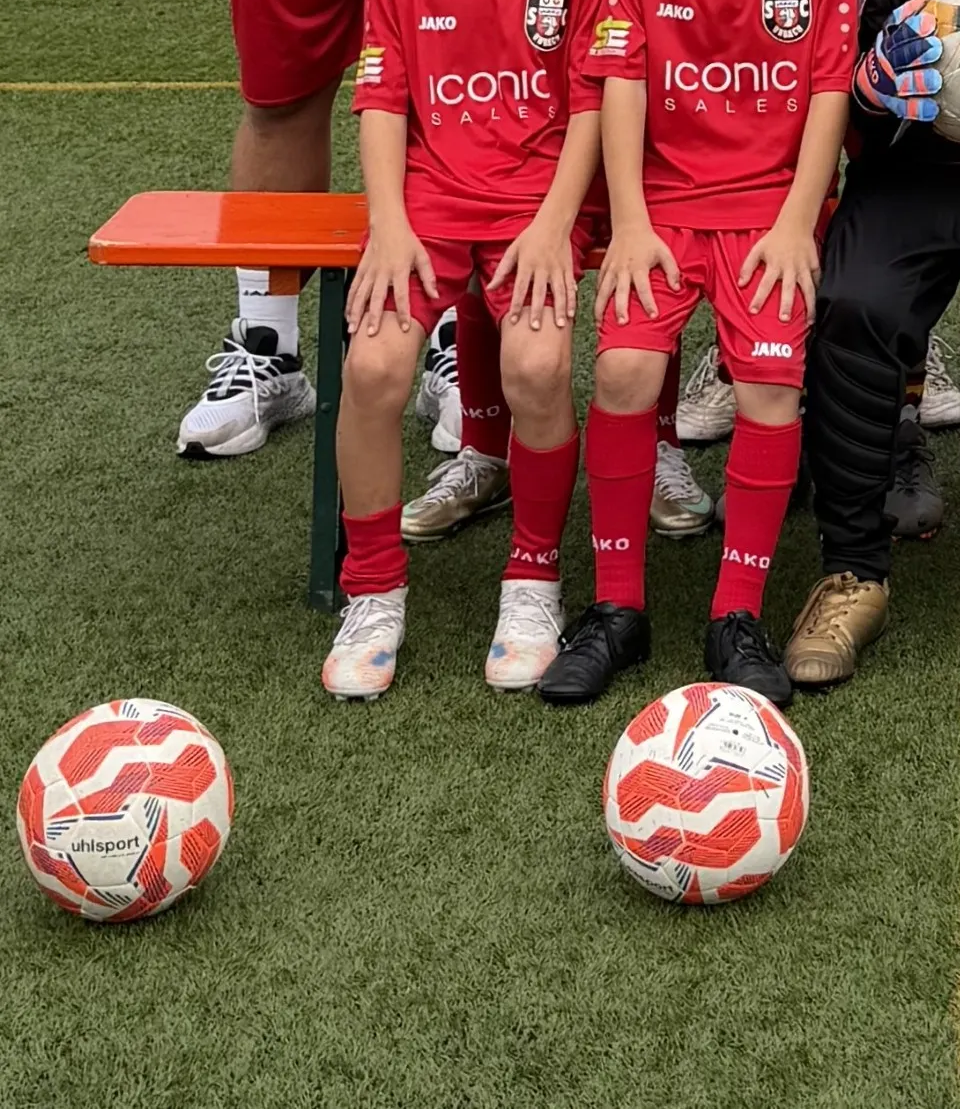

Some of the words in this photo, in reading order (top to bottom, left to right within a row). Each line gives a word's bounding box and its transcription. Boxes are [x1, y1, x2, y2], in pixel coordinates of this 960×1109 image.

[656, 2, 695, 21] JAKO
[418, 16, 457, 30] JAKO
[664, 98, 798, 114] SALES
[431, 106, 556, 126] SALES
[751, 341, 793, 358] JAKO
[510, 547, 559, 565] JAKO
[722, 547, 770, 569] JAKO
[72, 835, 141, 854] uhlsport
